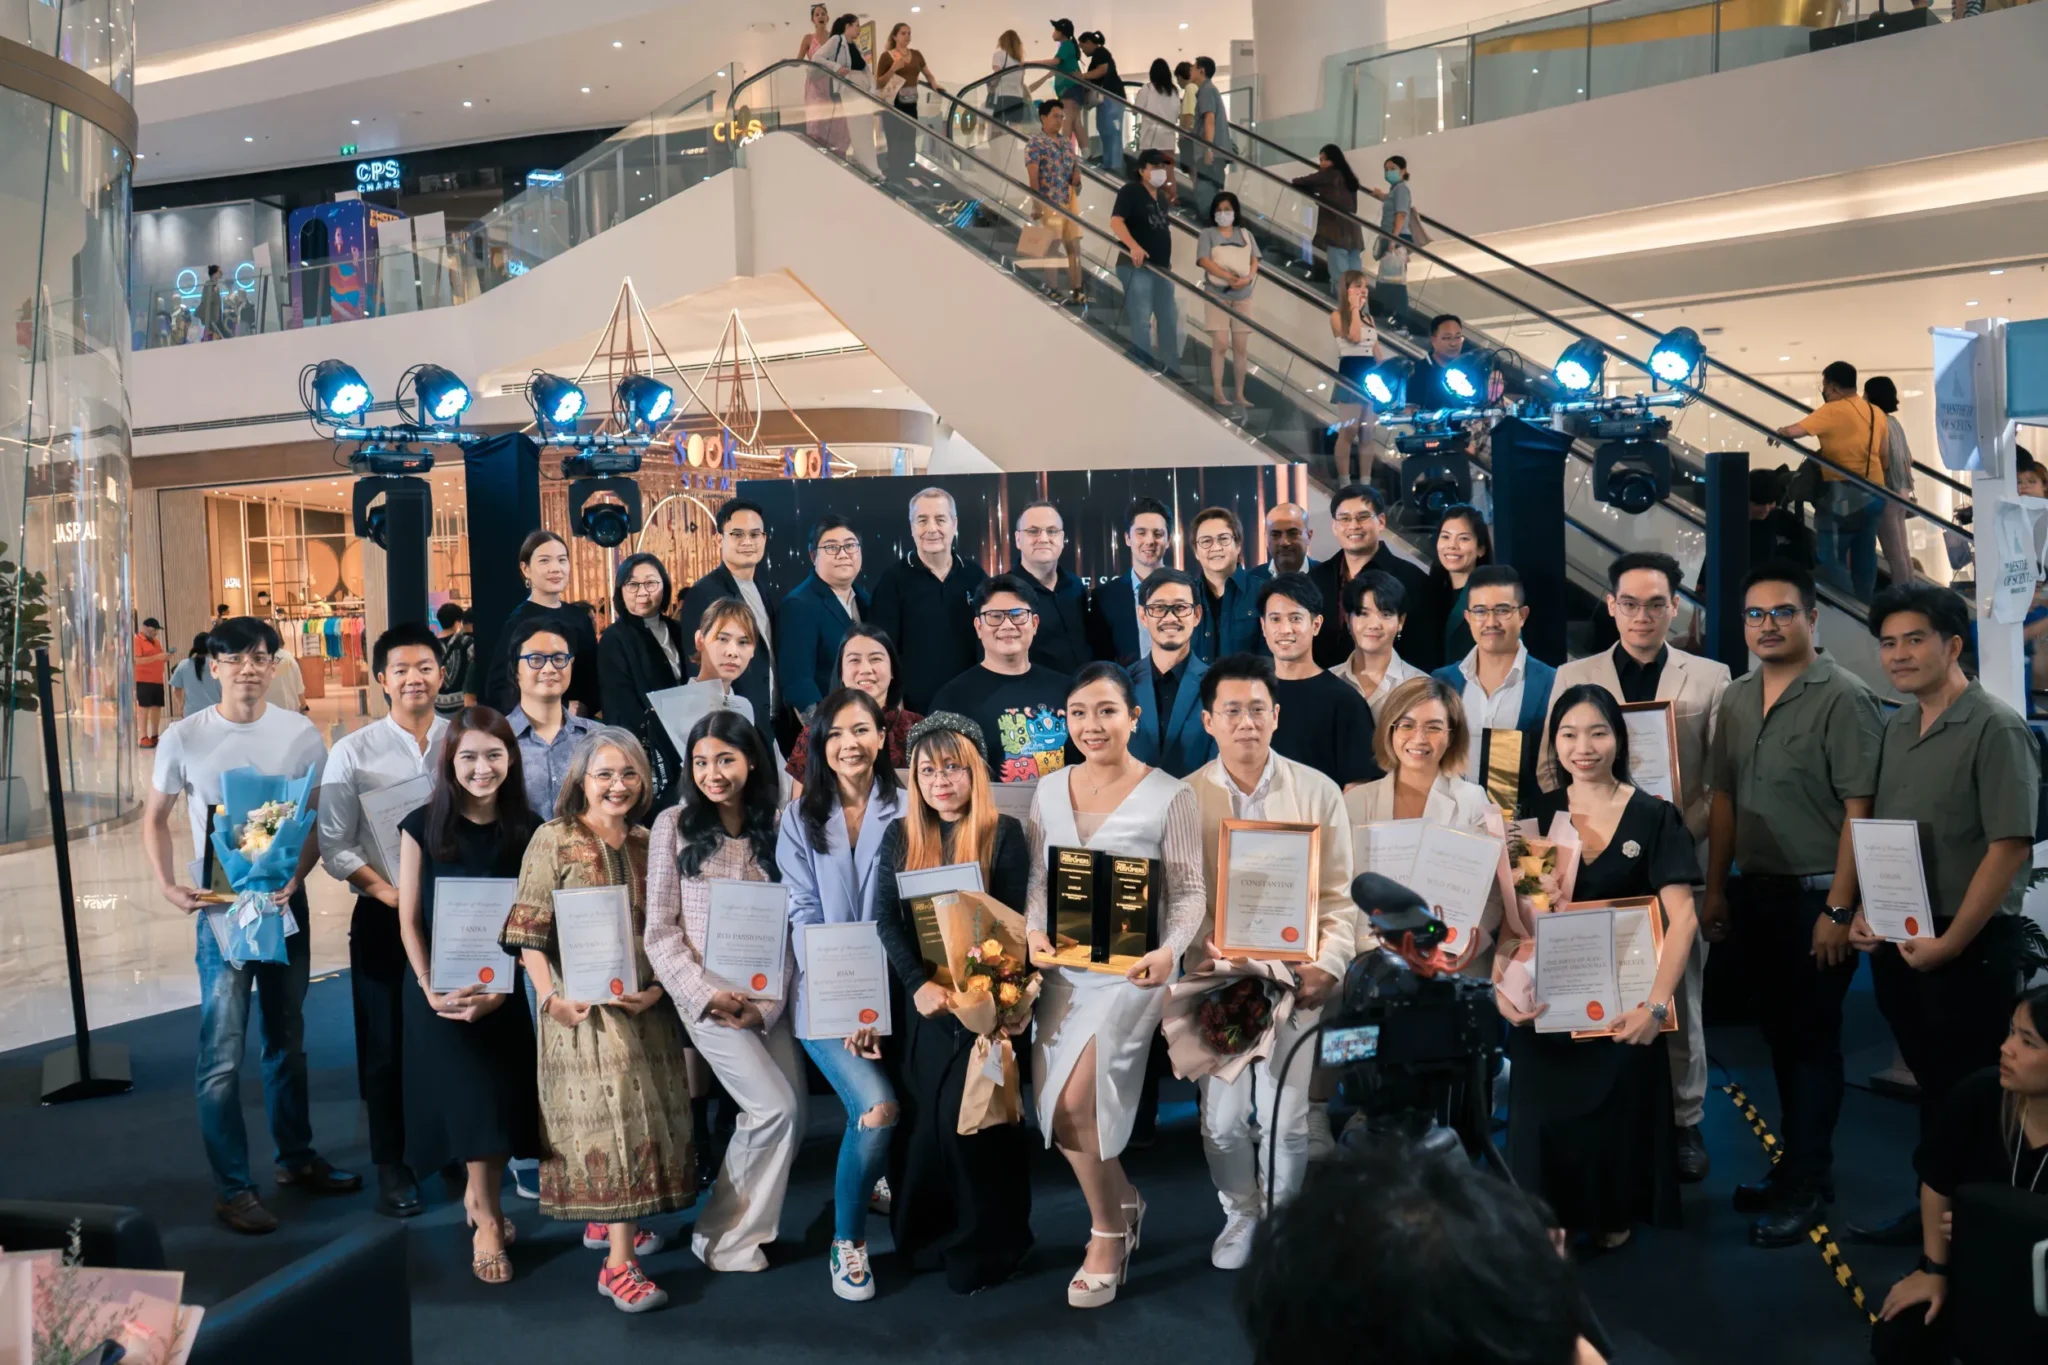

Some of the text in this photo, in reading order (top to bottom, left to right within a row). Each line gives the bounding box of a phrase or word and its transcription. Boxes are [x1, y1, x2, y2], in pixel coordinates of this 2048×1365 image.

[356, 160, 400, 182] CPS
[357, 179, 400, 193] CHAPS
[681, 472, 730, 491] SIAM
[1240, 879, 1294, 889] CONSTANTINE
